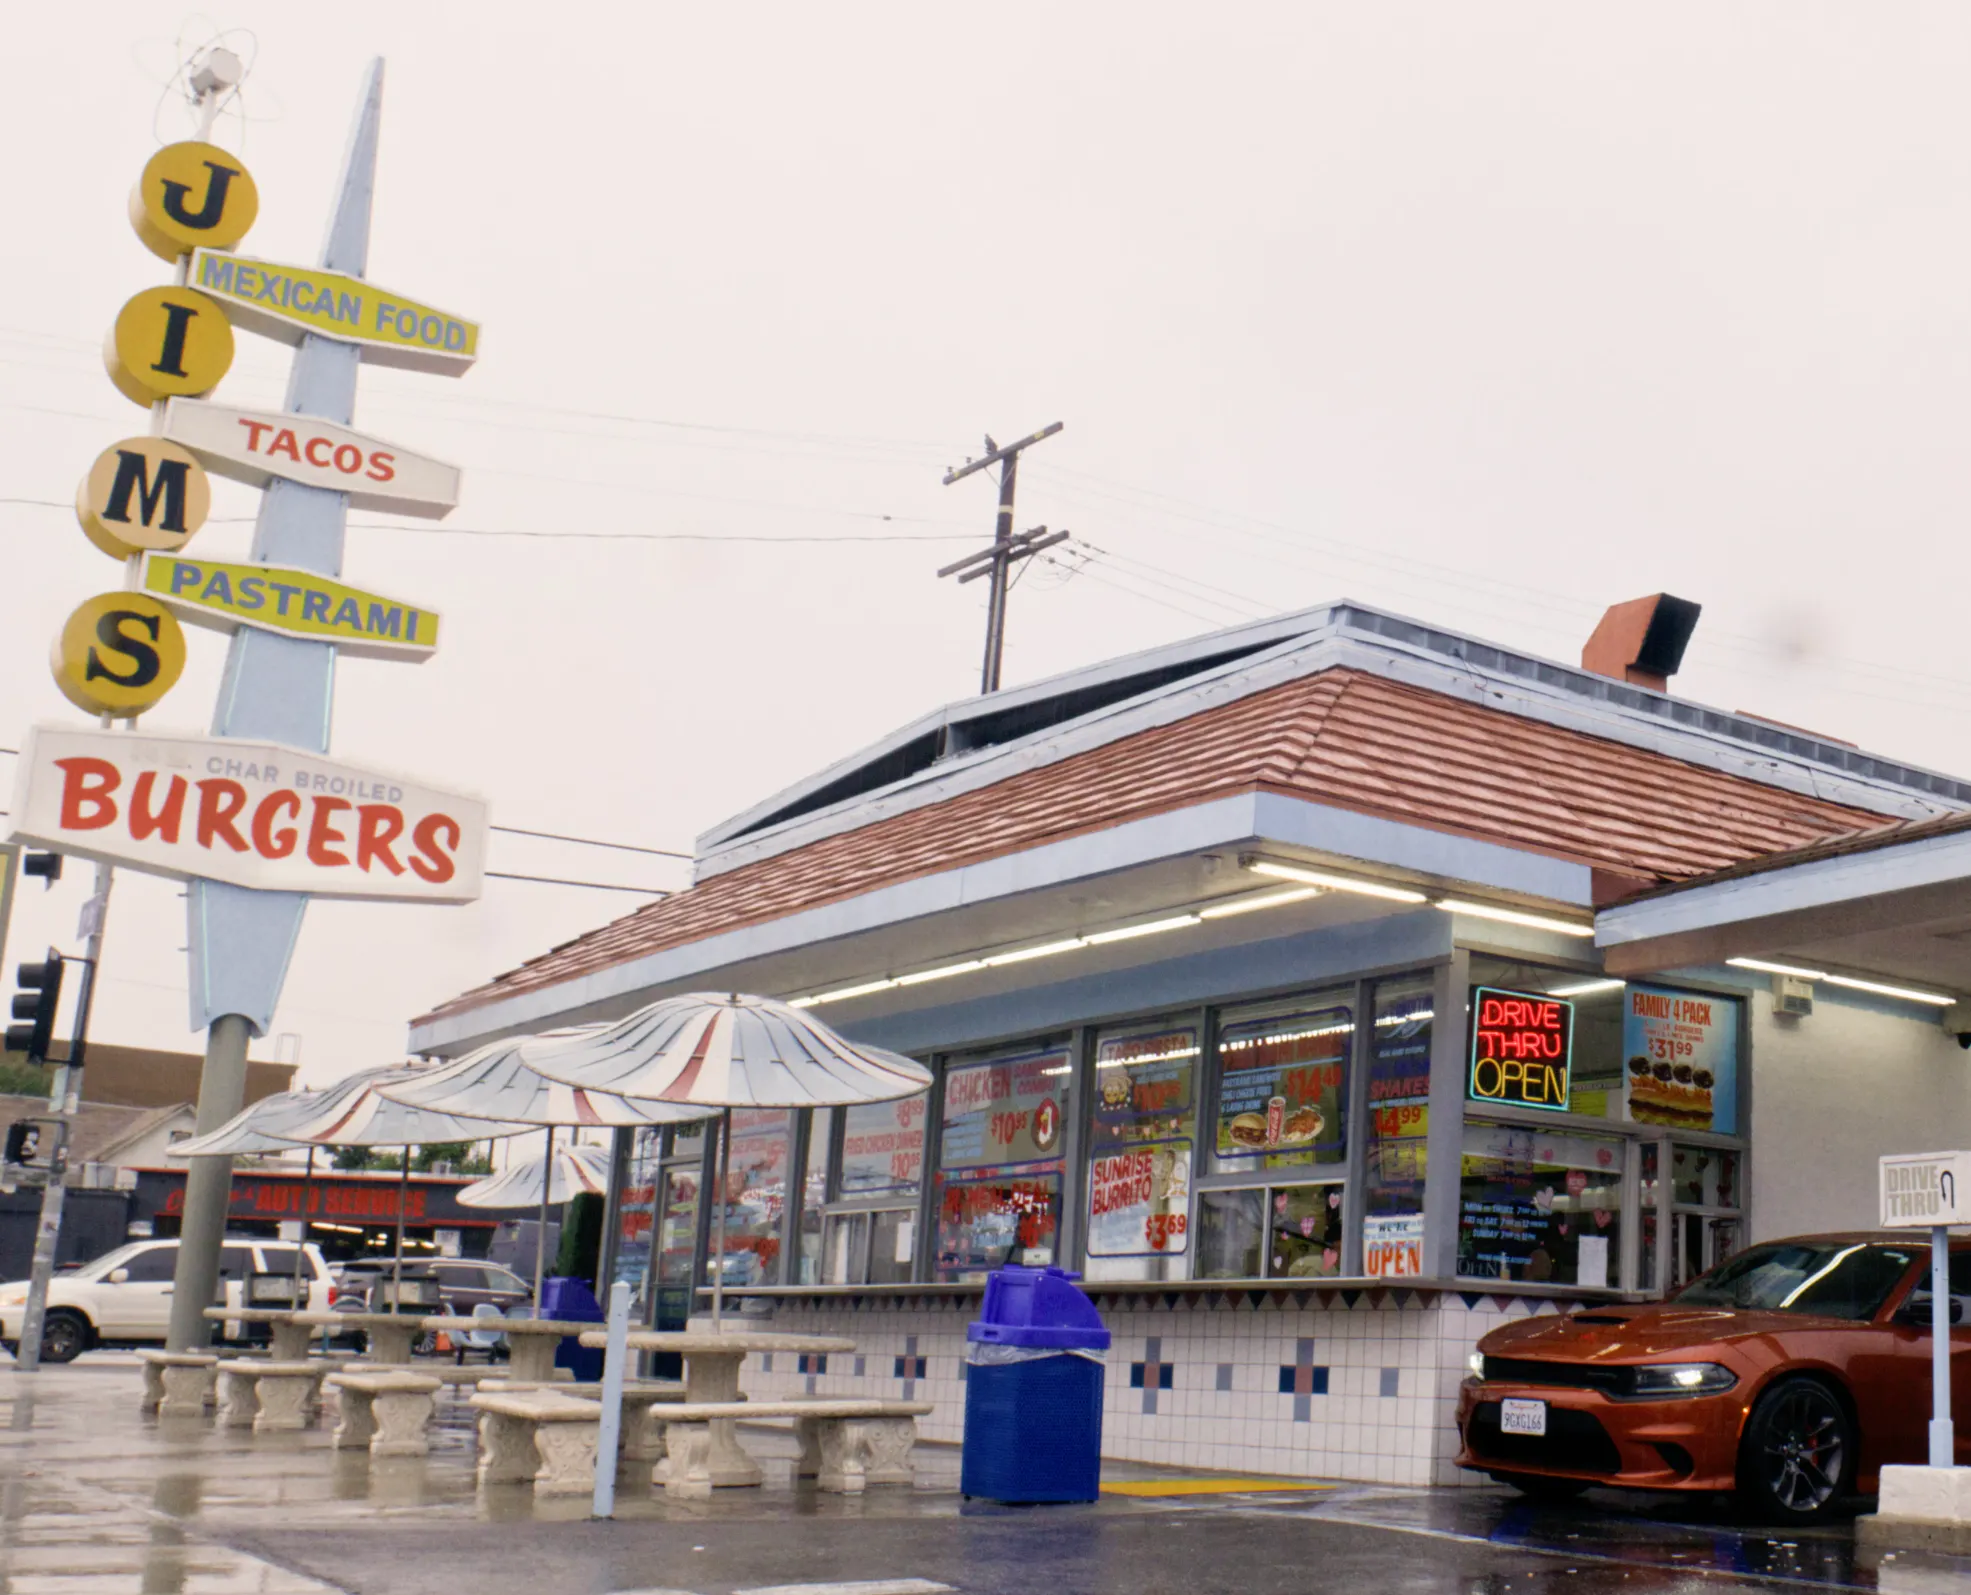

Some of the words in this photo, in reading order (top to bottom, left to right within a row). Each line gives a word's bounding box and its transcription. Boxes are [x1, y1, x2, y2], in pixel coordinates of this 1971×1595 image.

[202, 256, 363, 326] MEXICAN
[375, 302, 467, 352] FOOD
[238, 418, 397, 483] TACOS
[170, 562, 420, 642] PASTRAMI
[206, 756, 281, 784] CHAR
[295, 770, 405, 804] BROILED
[53, 756, 461, 884] BURGERS
[1482, 1000, 1561, 1029] DRIVE
[1633, 992, 1671, 1019] FAMILY
[1673, 999, 1681, 1021] 4
[1682, 1000, 1712, 1027] PACK
[1478, 1031, 1562, 1058] THRU
[949, 1066, 1011, 1105] CHICKEN
[1474, 1057, 1567, 1104] OPEN
[1093, 1148, 1154, 1186] SUNRISE
[1887, 1165, 1940, 1193] DRIVE
[1091, 1174, 1152, 1216] BURRITO
[1887, 1190, 1941, 1217] THRU
[1366, 1240, 1421, 1277] OPEN
